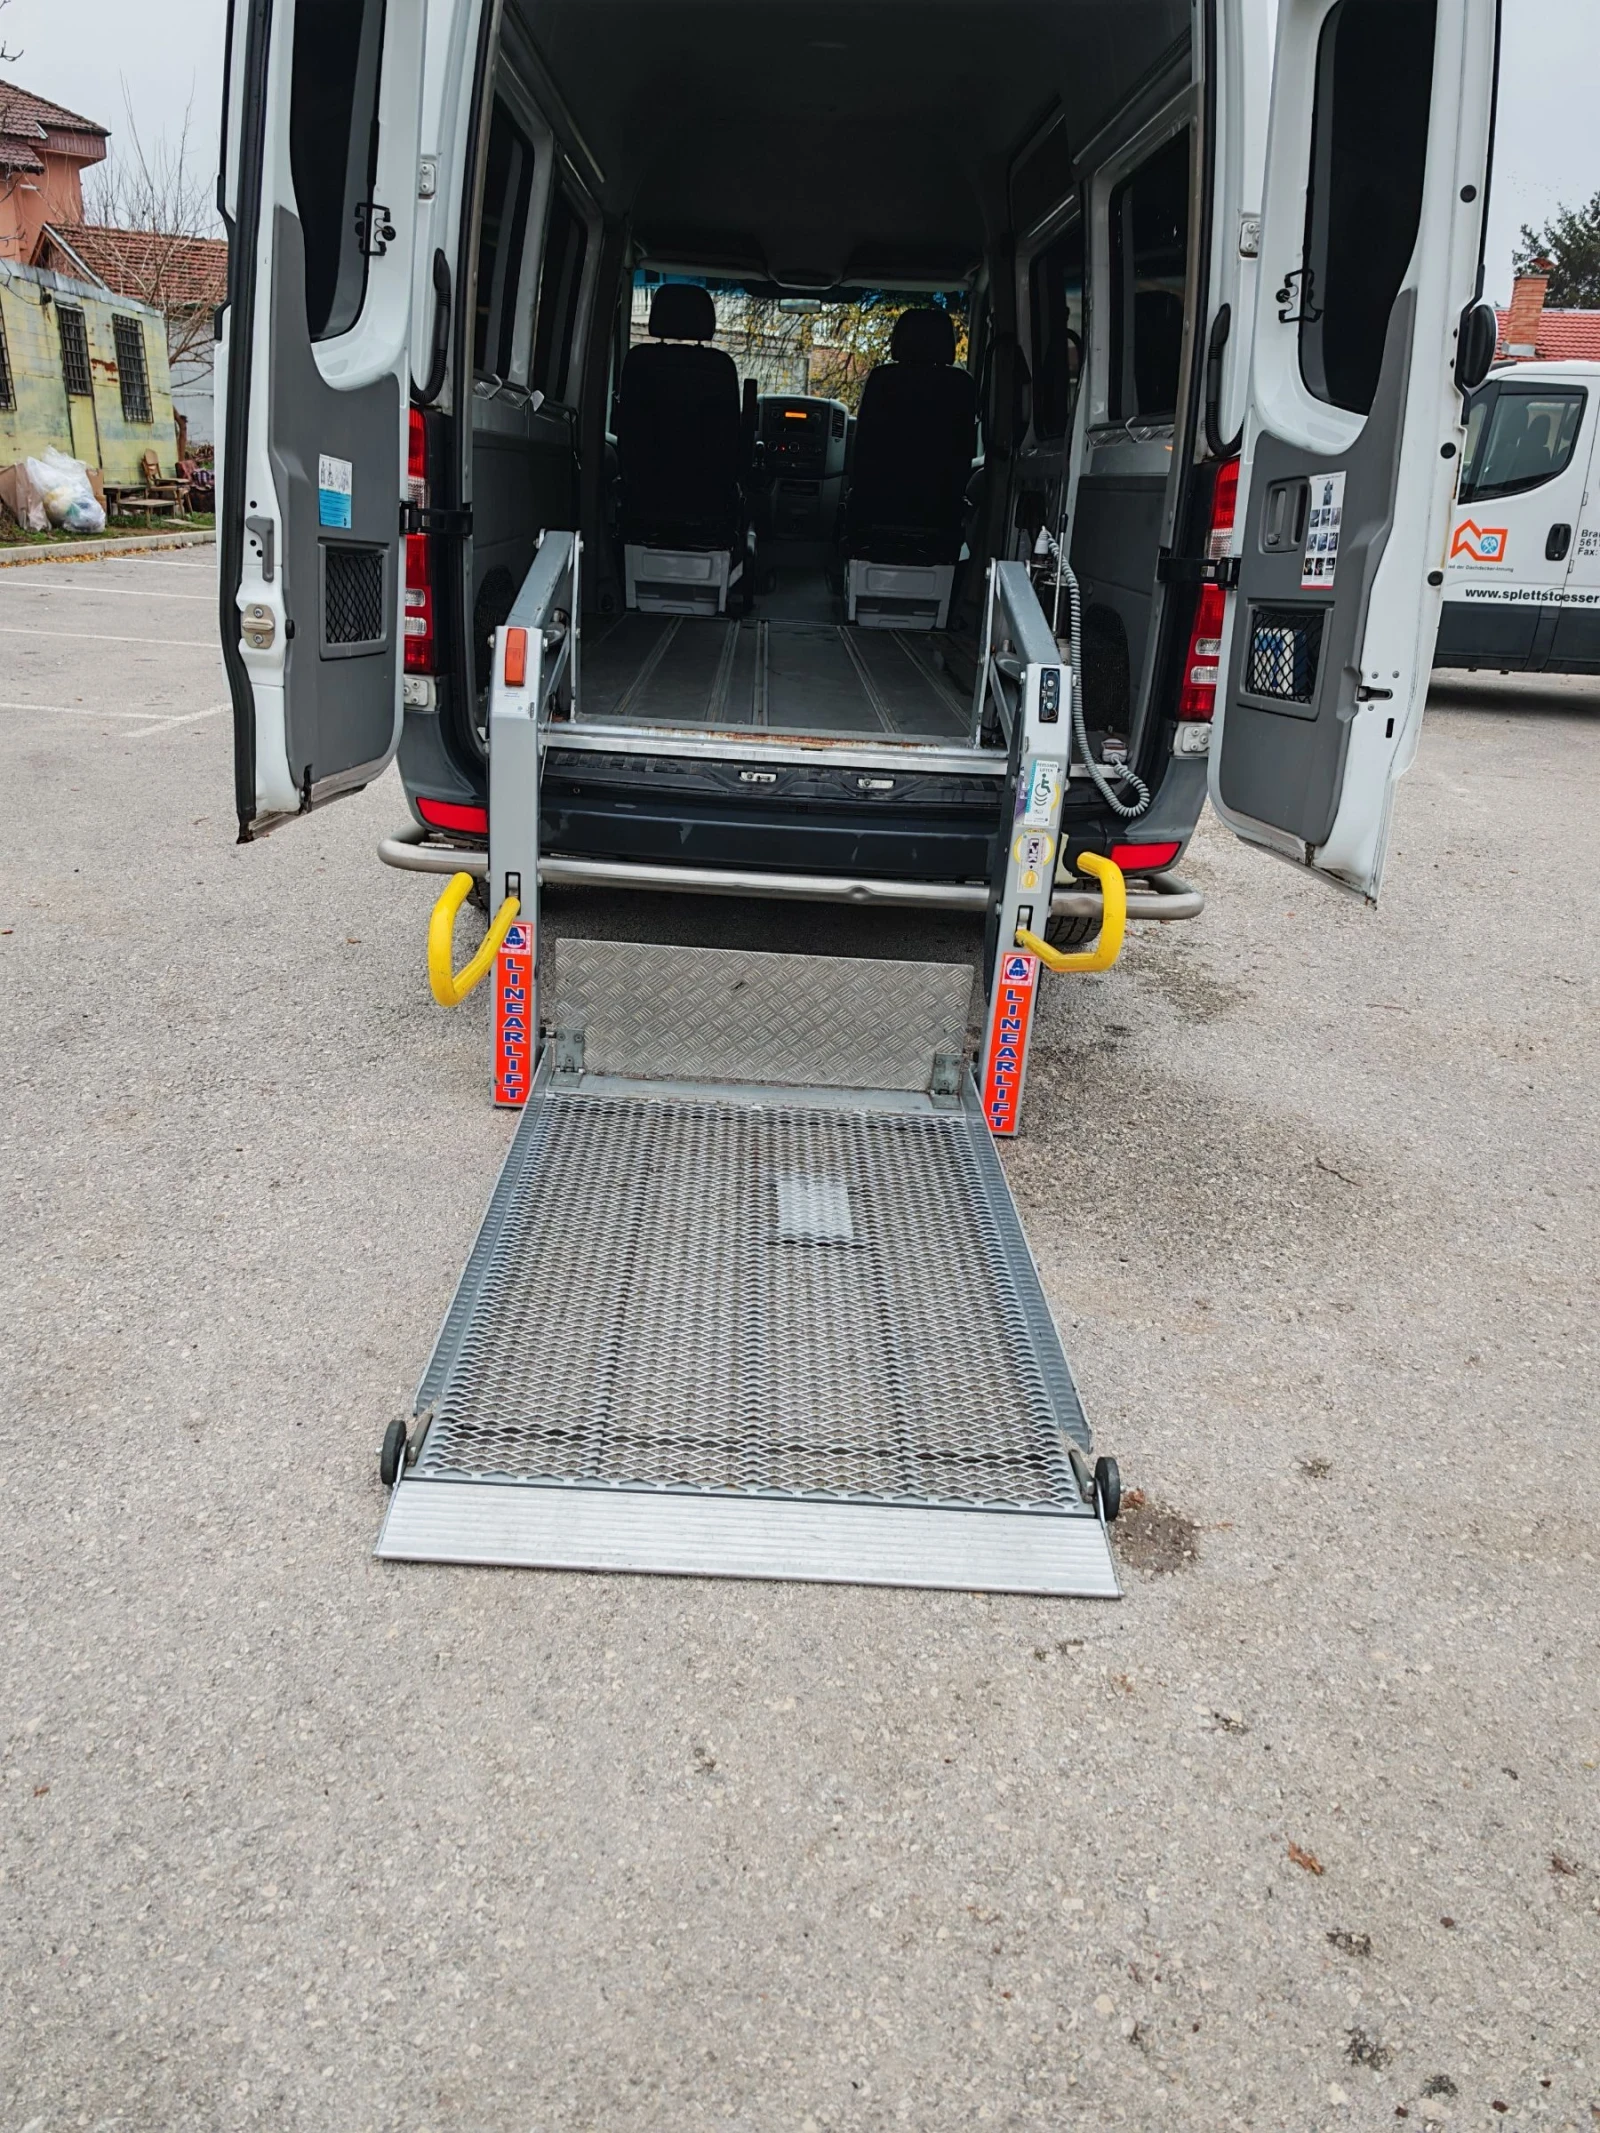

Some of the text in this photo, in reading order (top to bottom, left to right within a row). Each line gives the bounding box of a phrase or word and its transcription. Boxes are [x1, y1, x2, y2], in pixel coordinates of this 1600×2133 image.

[1581, 529, 1600, 538] Bra
[1579, 538, 1600, 547] 561
[1466, 589, 1600, 603] www.splettstoesser
[502, 958, 526, 1099] LINEARLIFT
[989, 988, 1025, 1128] LINEARLIFT
